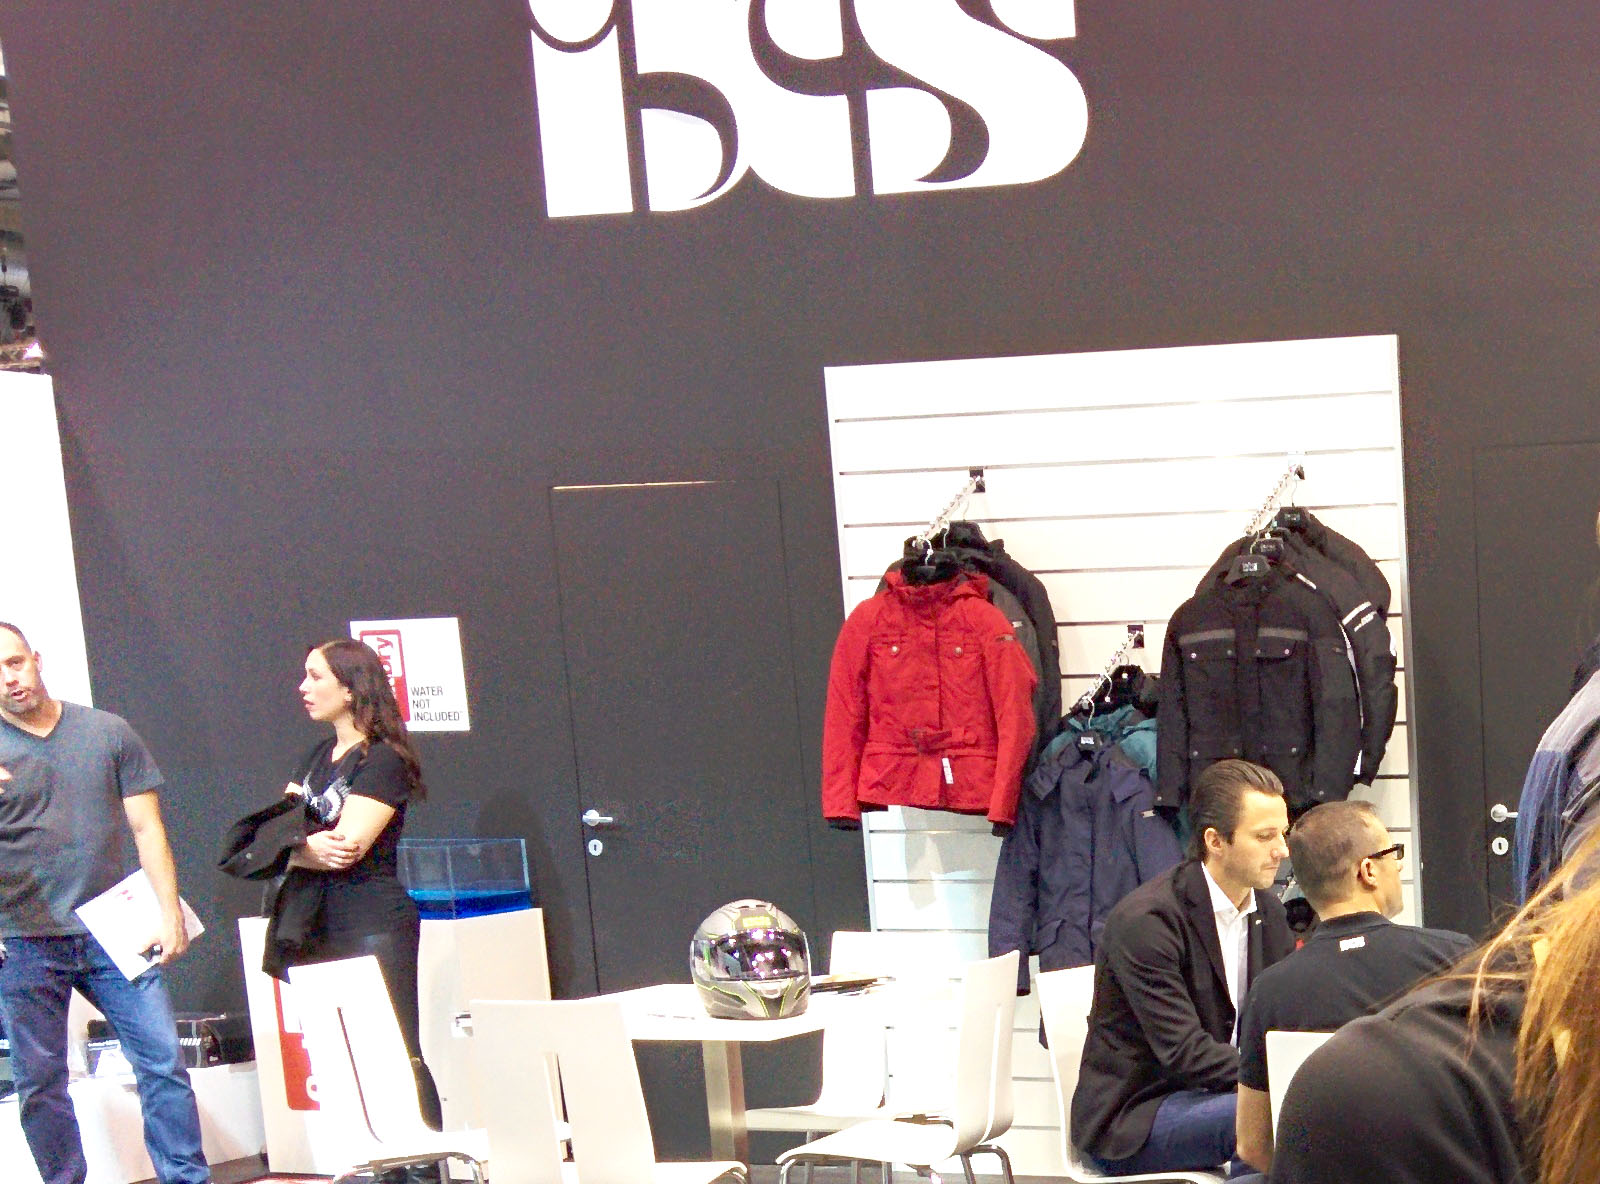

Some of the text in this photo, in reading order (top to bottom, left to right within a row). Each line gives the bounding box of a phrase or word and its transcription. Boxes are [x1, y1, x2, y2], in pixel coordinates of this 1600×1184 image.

[411, 686, 443, 696] WATER
[412, 699, 430, 709] NOT
[414, 711, 460, 721] INCLUDED
